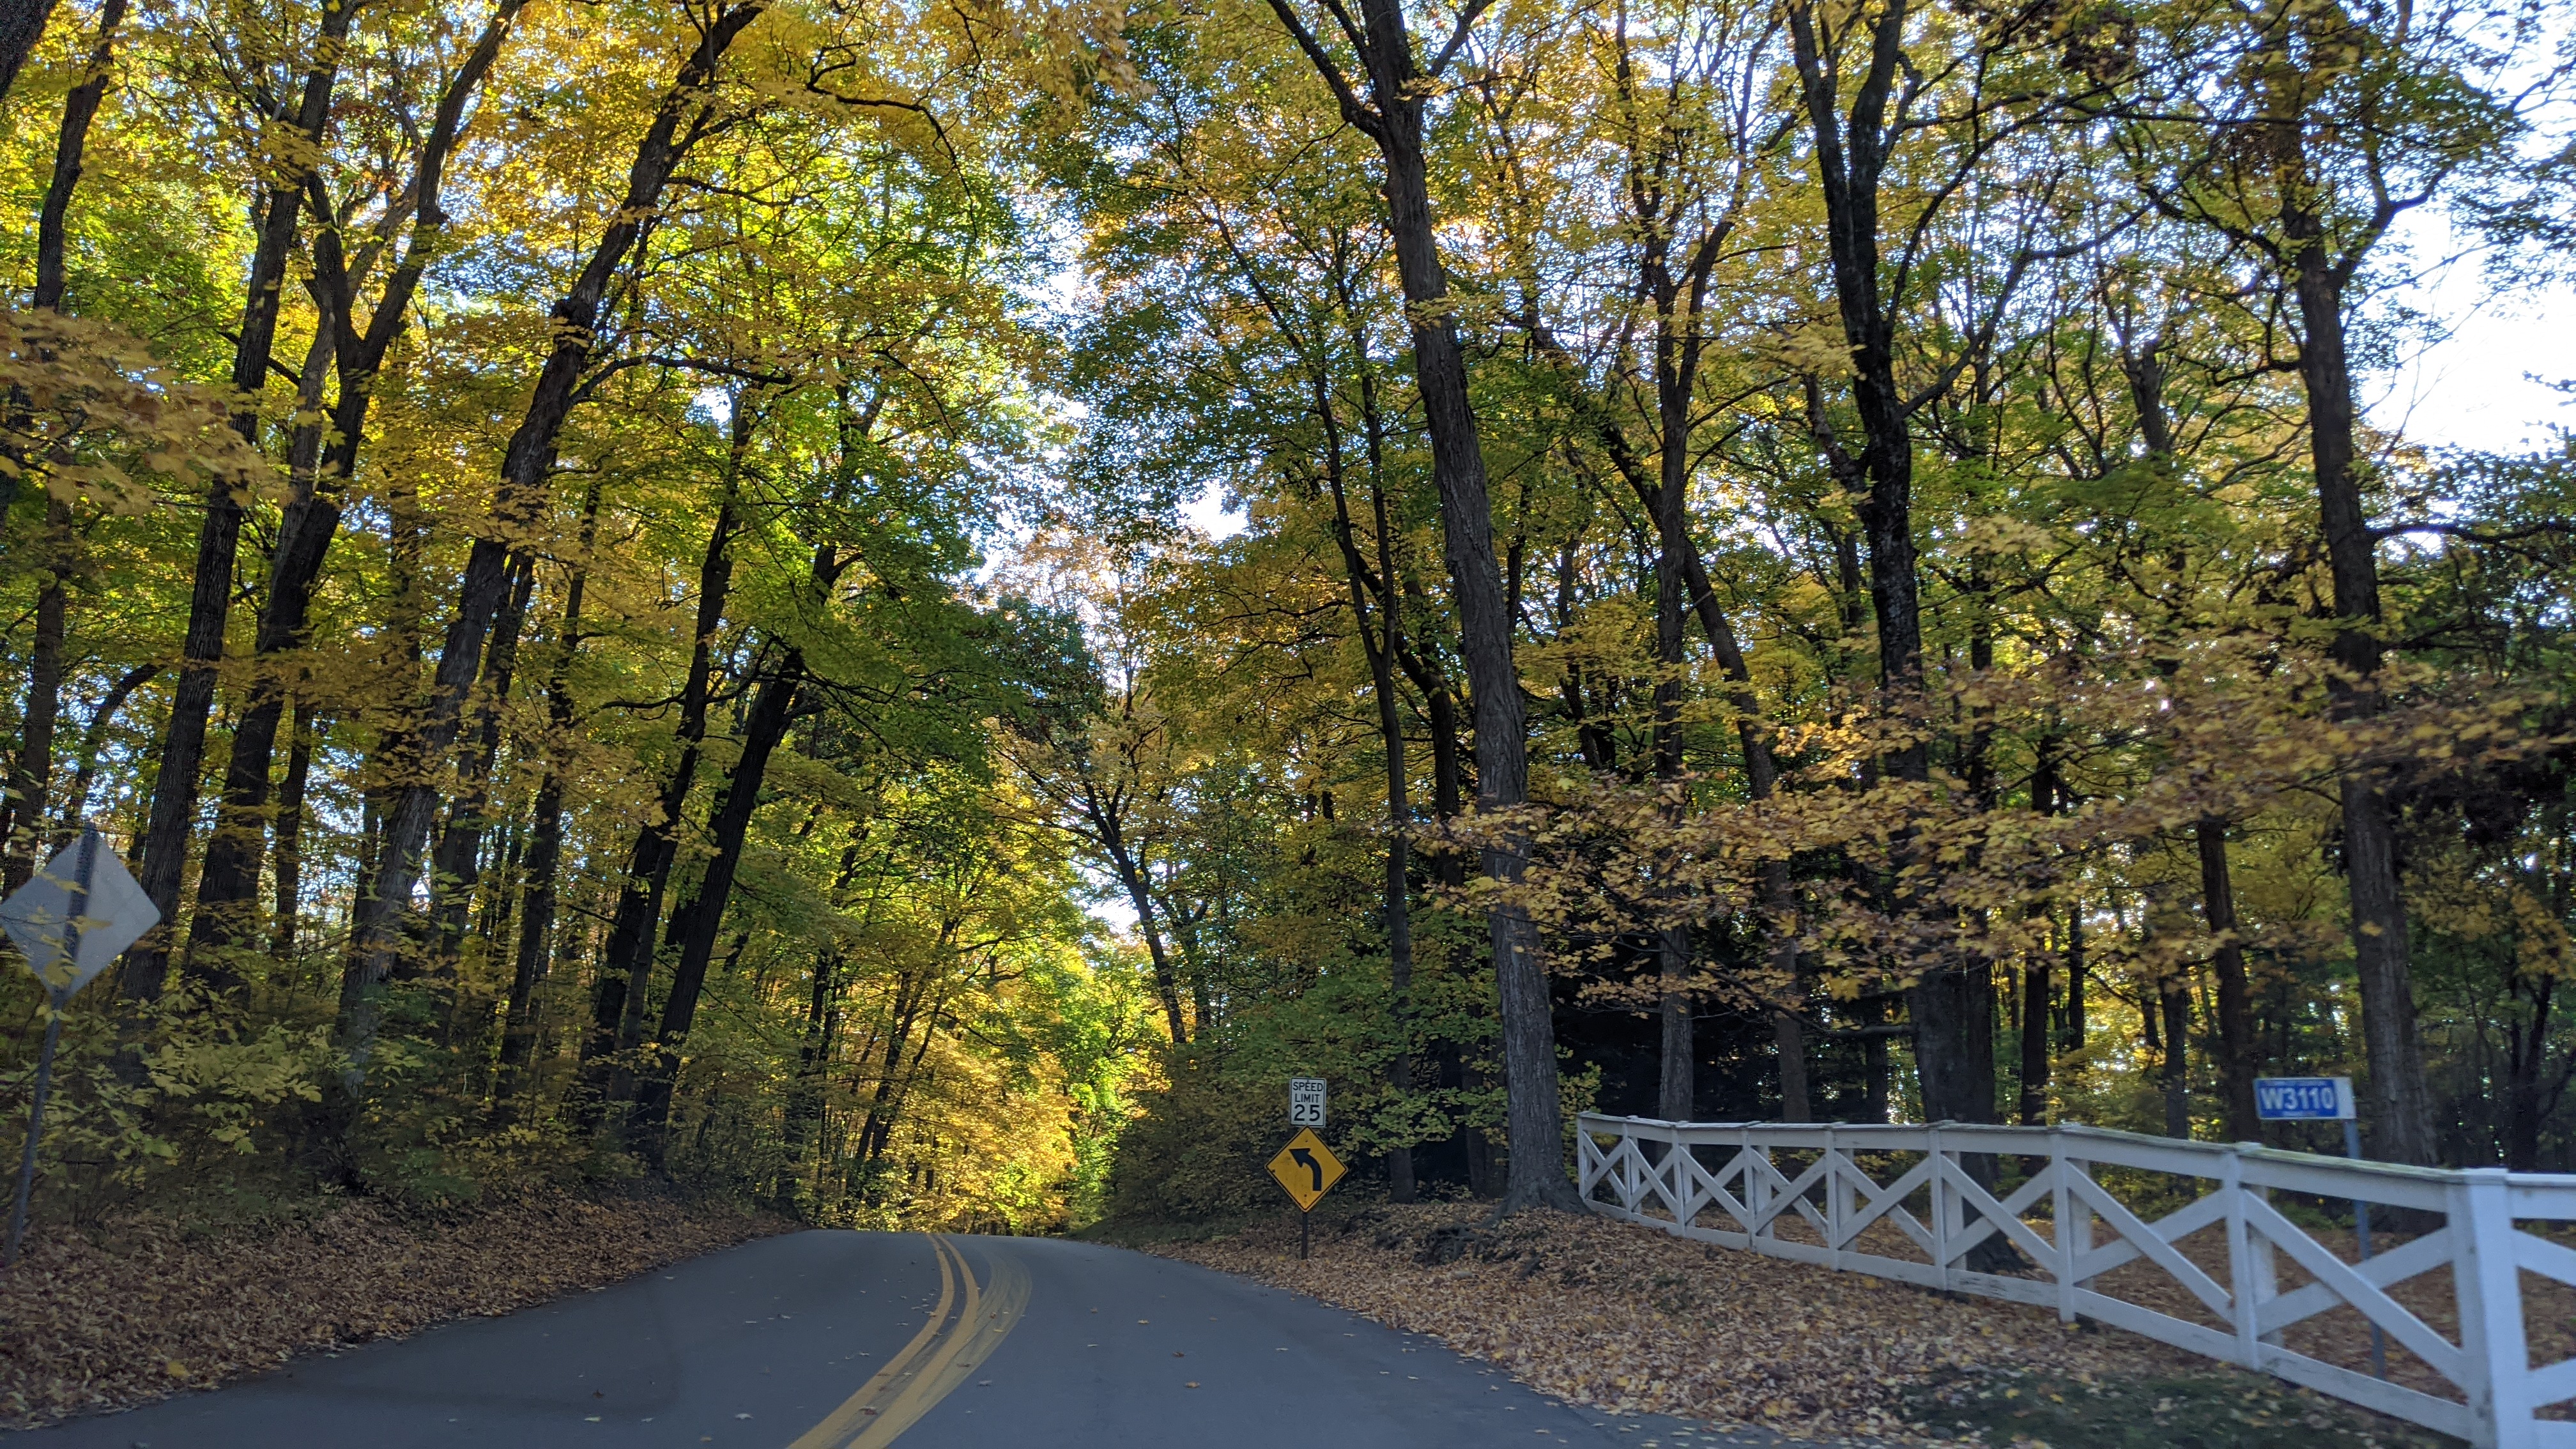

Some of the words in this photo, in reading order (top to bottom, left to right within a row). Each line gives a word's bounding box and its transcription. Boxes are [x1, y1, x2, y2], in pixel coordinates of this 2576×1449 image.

[1292, 1082, 1323, 1091] SPEED
[1295, 1094, 1320, 1103] LIMIT
[2260, 1087, 2334, 1109] W3110
[1294, 1104, 1321, 1121] 25
